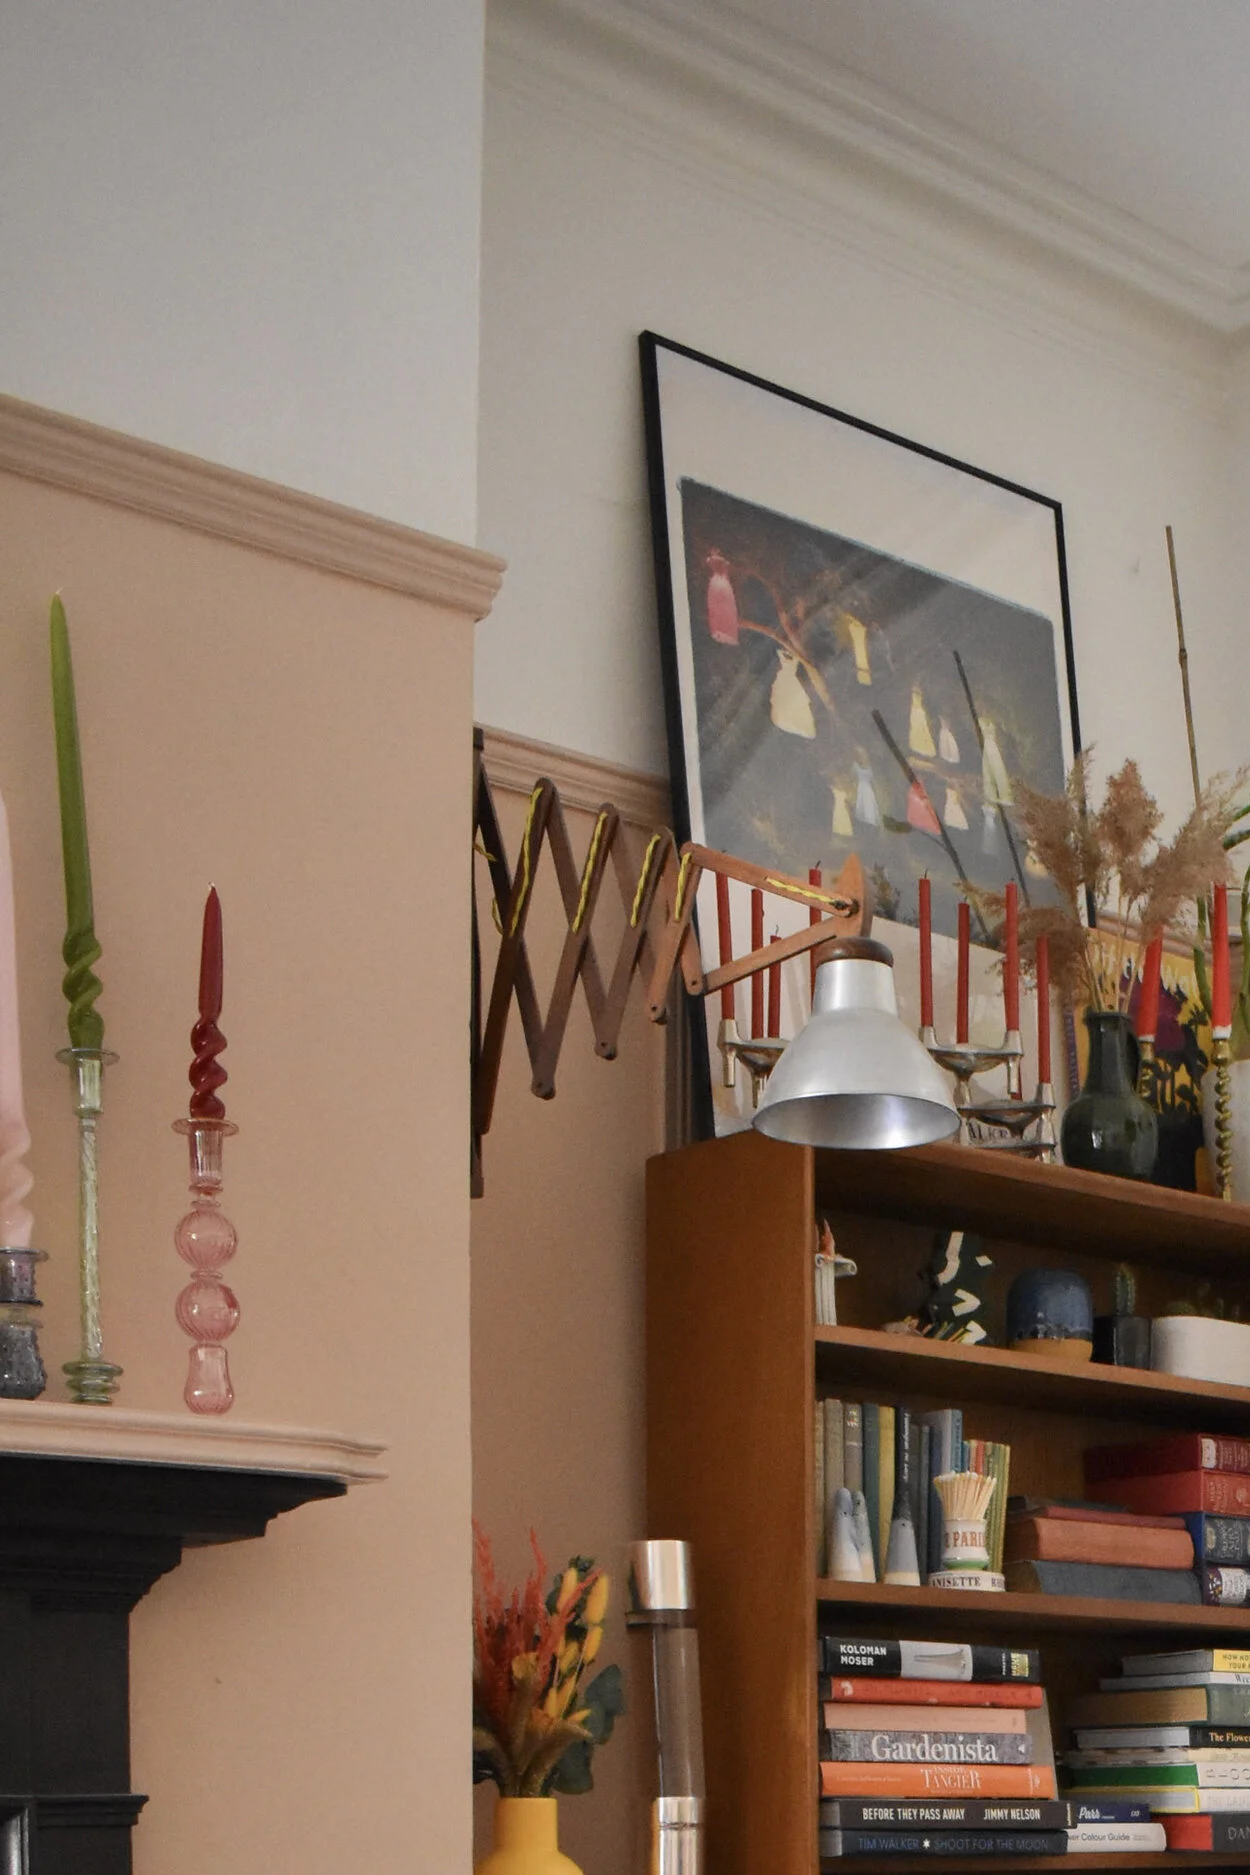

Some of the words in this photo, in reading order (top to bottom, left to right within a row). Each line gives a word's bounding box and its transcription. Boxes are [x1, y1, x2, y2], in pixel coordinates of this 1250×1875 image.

[840, 1644, 887, 1656] KOLOMAN
[841, 1655, 874, 1666] MOSER
[1208, 1732, 1224, 1742] The
[871, 1733, 998, 1763] Gardenista
[920, 1768, 981, 1790] TANGIER
[862, 1807, 895, 1821] BEFORE
[897, 1808, 918, 1821] THEY
[919, 1808, 940, 1820] PASS
[941, 1808, 965, 1820] AWAY
[983, 1808, 1008, 1820] JIMMY
[1010, 1808, 1041, 1820] NELSON
[1081, 1832, 1106, 1841] Colour
[1108, 1832, 1130, 1841] Guide
[858, 1837, 878, 1850] TIM
[879, 1837, 920, 1850] WALKER
[934, 1838, 970, 1851] SHOOT
[971, 1838, 991, 1851] FOR
[992, 1838, 1014, 1851] THE
[1016, 1838, 1049, 1851] MOON
